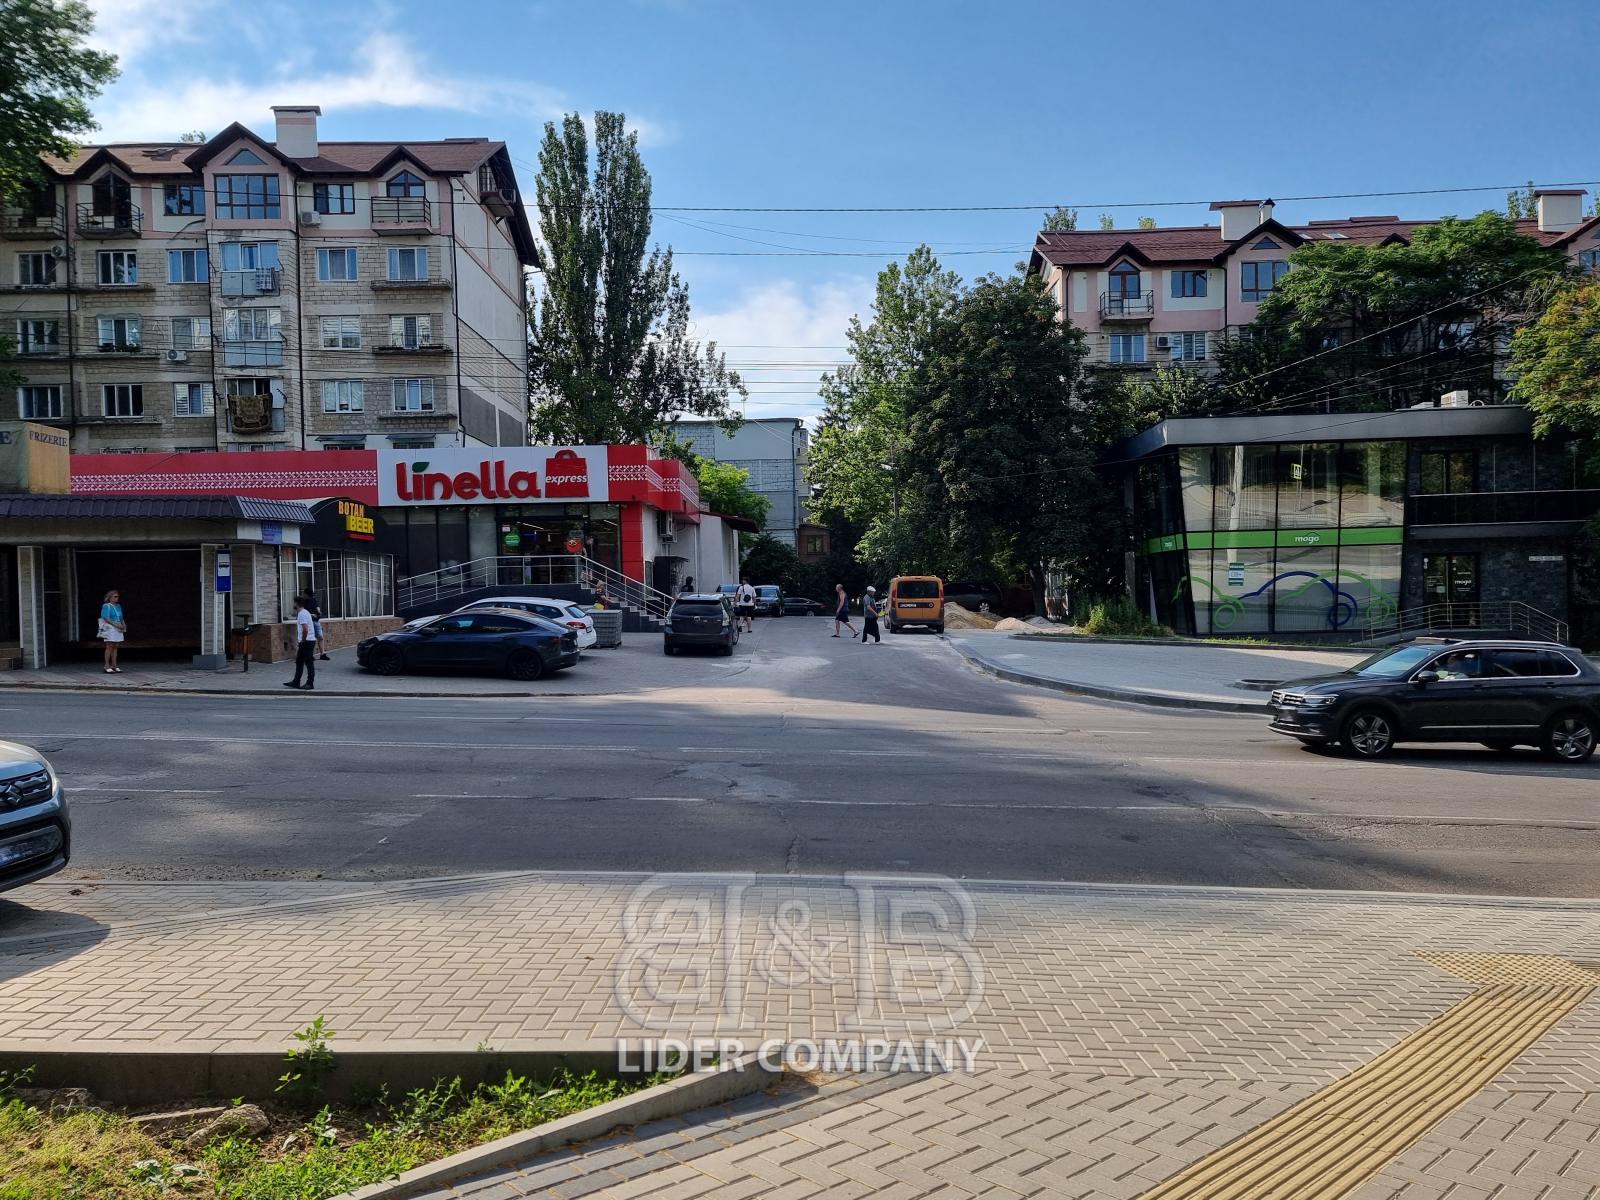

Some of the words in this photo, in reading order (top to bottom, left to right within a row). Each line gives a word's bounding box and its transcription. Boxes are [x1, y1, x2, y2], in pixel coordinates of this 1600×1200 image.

[29, 430, 68, 447] FRIZERIE
[395, 459, 541, 501] linella
[545, 473, 588, 485] express
[350, 515, 374, 534] BEER
[1295, 536, 1320, 545] mogo
